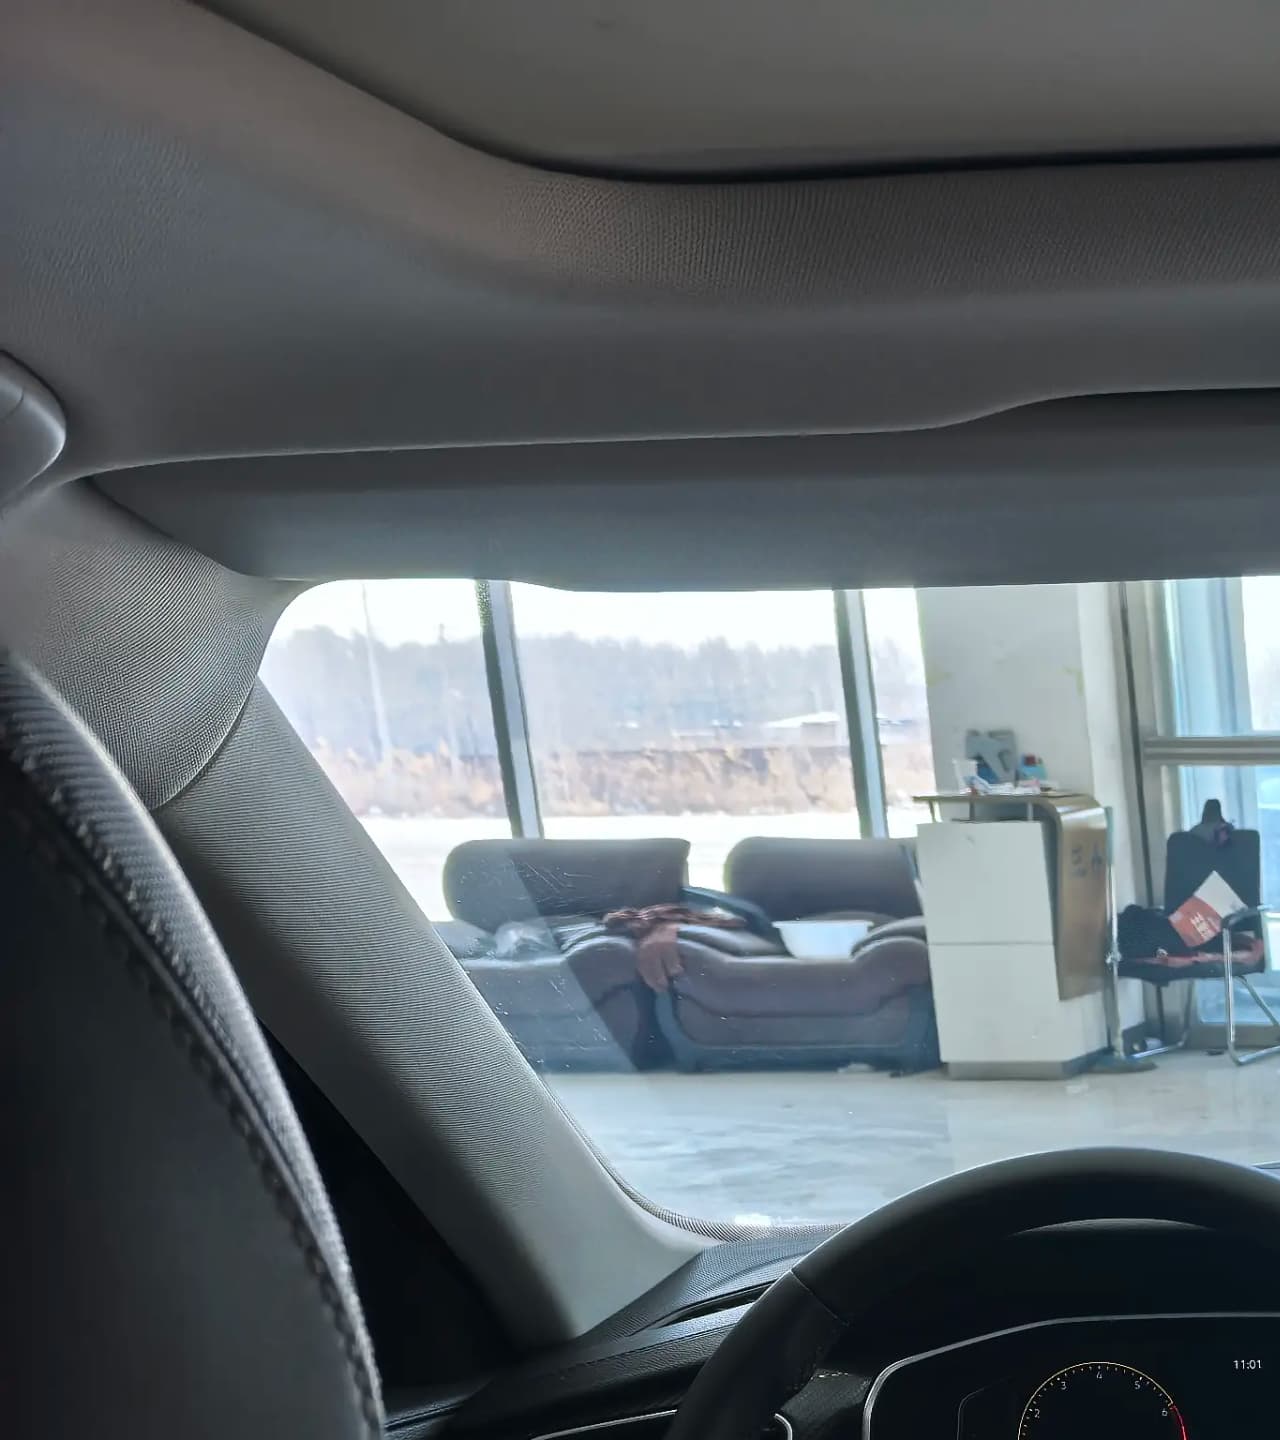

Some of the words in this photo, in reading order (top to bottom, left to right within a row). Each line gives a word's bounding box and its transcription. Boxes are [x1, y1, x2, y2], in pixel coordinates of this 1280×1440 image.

[1232, 1359, 1263, 1370] 11:01
[1095, 1370, 1103, 1380] 4
[1060, 1380, 1068, 1391] 3
[1134, 1380, 1141, 1390] 5
[1034, 1408, 1041, 1418] 2
[1161, 1408, 1168, 1417] 6
